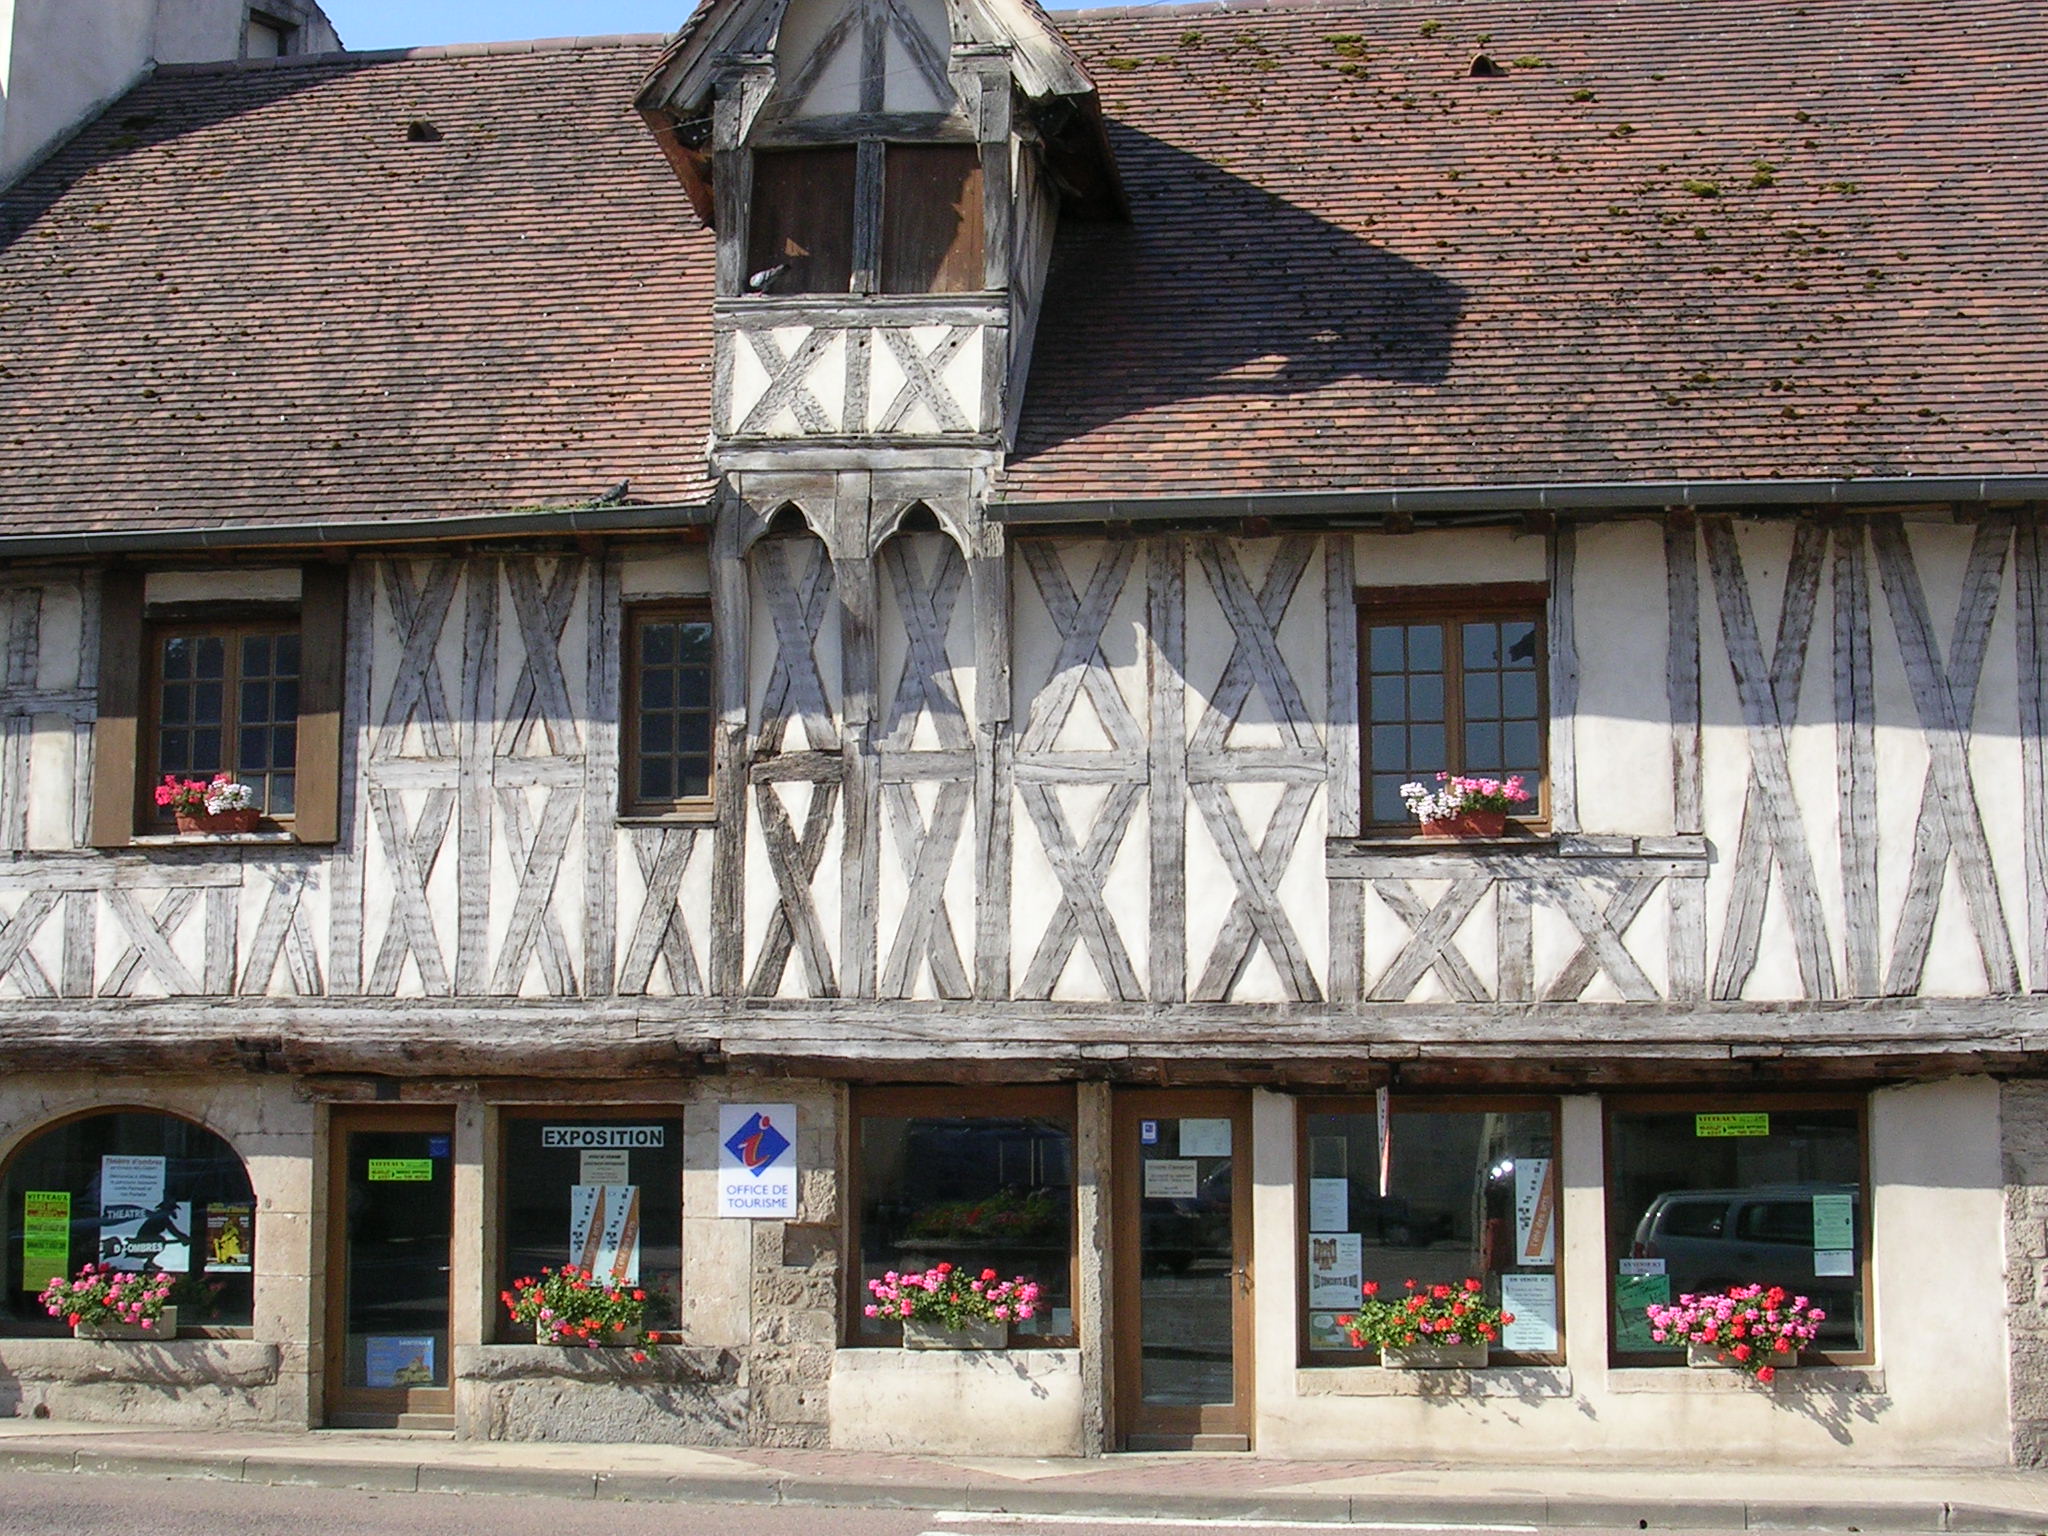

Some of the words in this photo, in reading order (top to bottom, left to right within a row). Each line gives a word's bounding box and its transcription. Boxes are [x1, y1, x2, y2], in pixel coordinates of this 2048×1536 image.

[544, 1130, 663, 1145] EXPOSITION
[726, 1184, 769, 1195] OFFICE
[772, 1184, 788, 1195] DE
[728, 1198, 788, 1208] TOURISME
[106, 1209, 146, 1219] THEATRE
